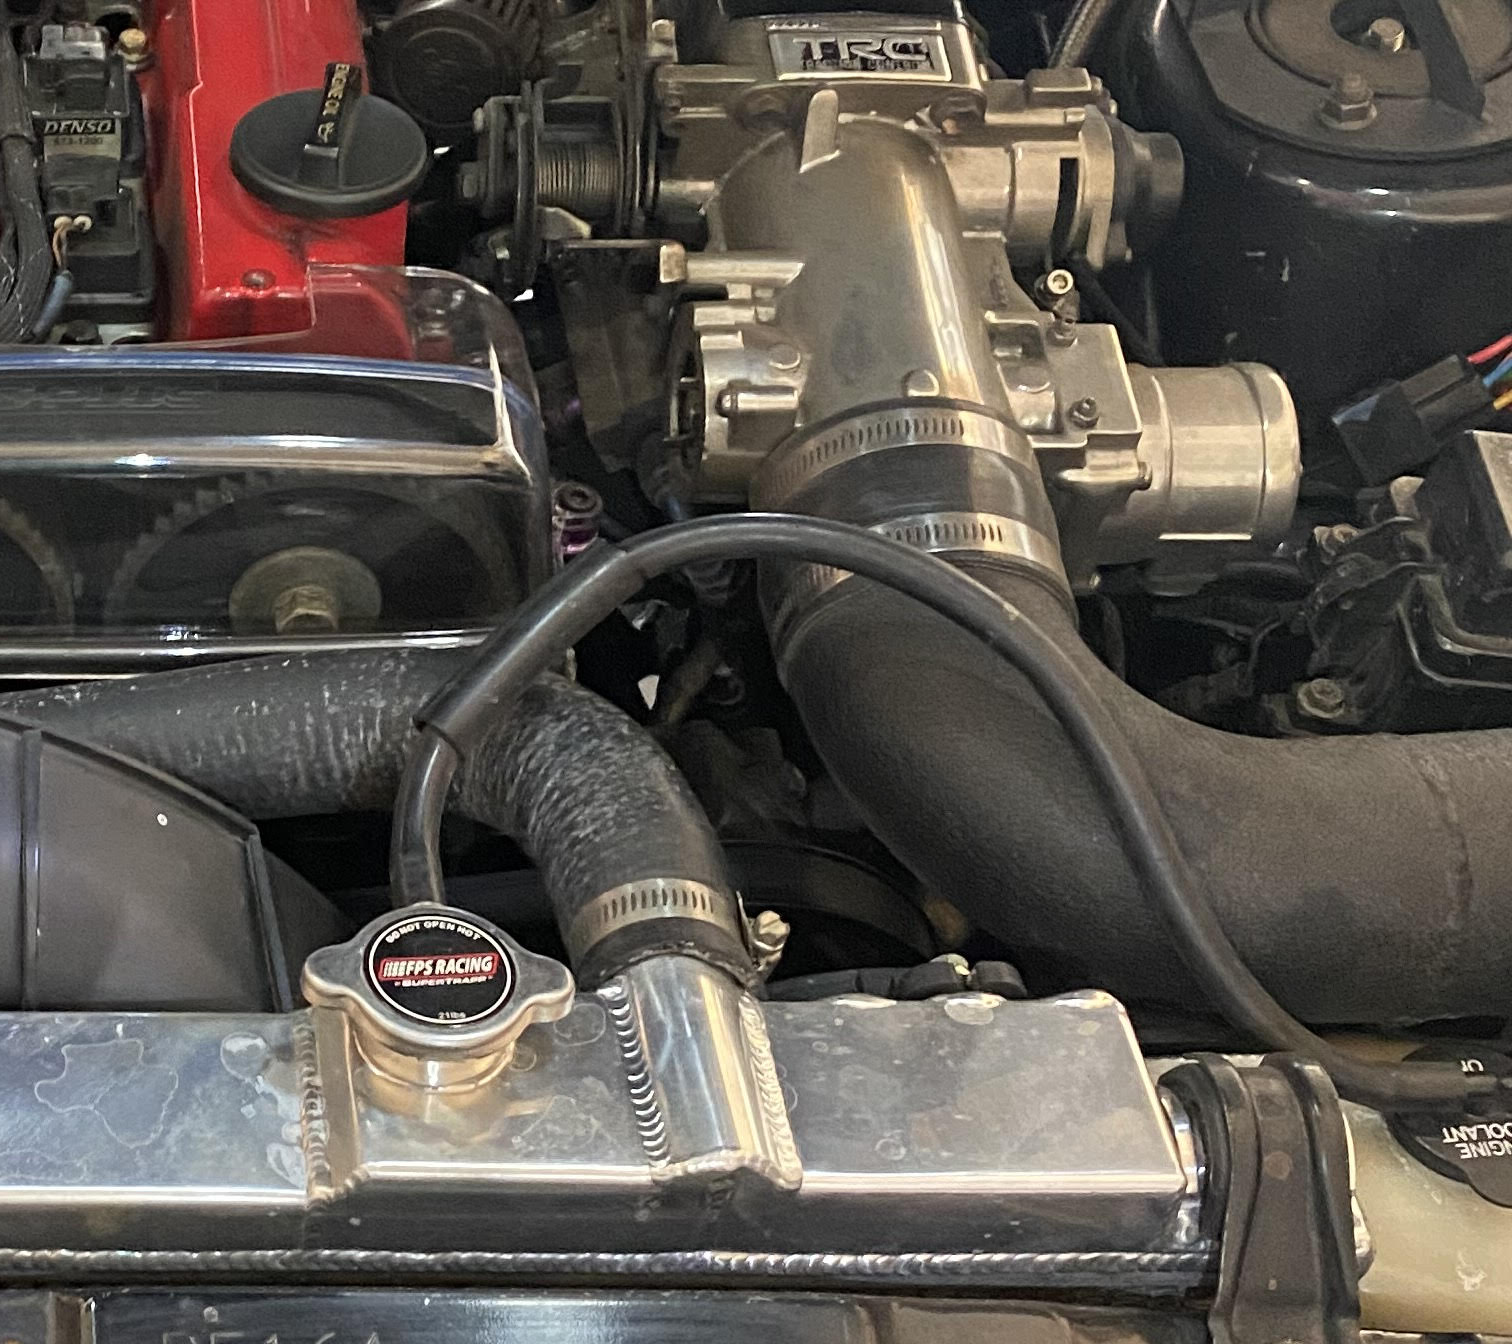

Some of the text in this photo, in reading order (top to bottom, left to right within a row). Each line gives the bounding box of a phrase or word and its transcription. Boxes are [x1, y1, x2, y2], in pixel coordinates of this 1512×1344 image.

[793, 37, 928, 61] TRC
[327, 63, 351, 99] ENGINE
[43, 119, 113, 134] DENSO
[385, 920, 481, 944] DO NOT OPEN HOT
[434, 956, 493, 975] RACING
